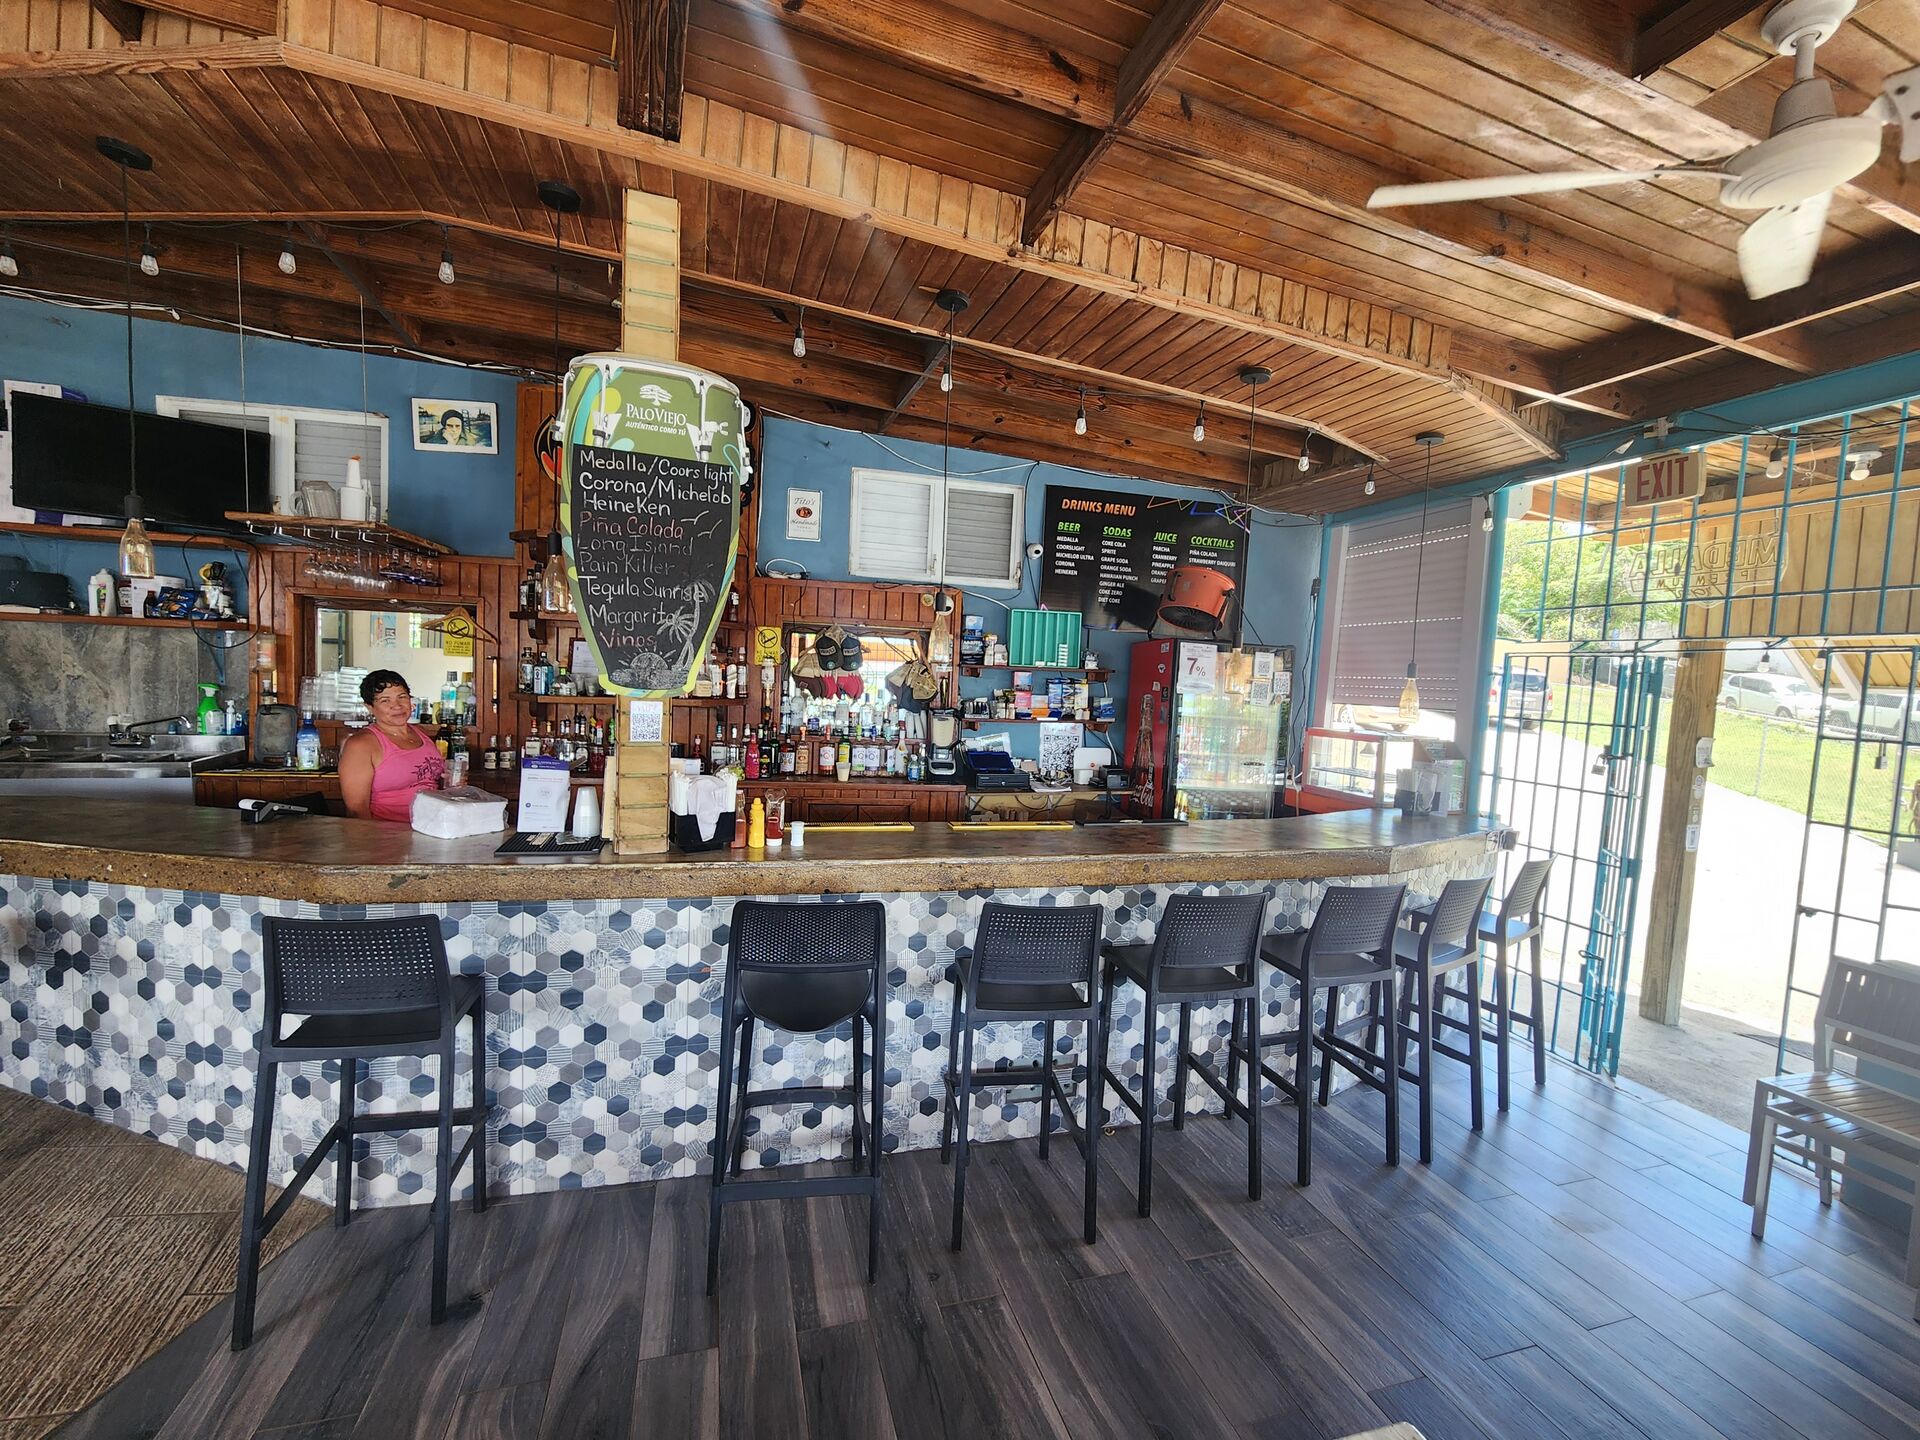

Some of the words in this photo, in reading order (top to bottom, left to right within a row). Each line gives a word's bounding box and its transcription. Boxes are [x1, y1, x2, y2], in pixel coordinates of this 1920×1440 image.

[625, 421, 659, 432] AUTÉNTICO
[660, 426, 678, 434] COMO
[678, 428, 686, 436] TÚ
[704, 462, 734, 489] light
[1636, 456, 1689, 502] EXIT
[579, 472, 732, 505] Corona/Michelob
[793, 497, 816, 506] Tito's
[1062, 498, 1103, 514] DRINKS
[1104, 503, 1137, 517] MENU
[579, 511, 622, 535] Piña
[626, 517, 684, 540] Colada
[1057, 522, 1081, 532] BEER
[1102, 526, 1132, 538] SODAS
[1153, 532, 1178, 542] JUICE
[1190, 536, 1235, 548] COCKTAILS
[577, 533, 626, 560] Long
[579, 552, 618, 574] Pain
[624, 553, 676, 576] Killer
[1152, 554, 1178, 562] CRANBERRY
[1152, 562, 1174, 570] PINEAPPLE
[1188, 558, 1216, 566] STRAWBERRY
[578, 575, 640, 603] Tequila
[642, 576, 705, 602] Sunrise
[588, 602, 676, 632] Margarita
